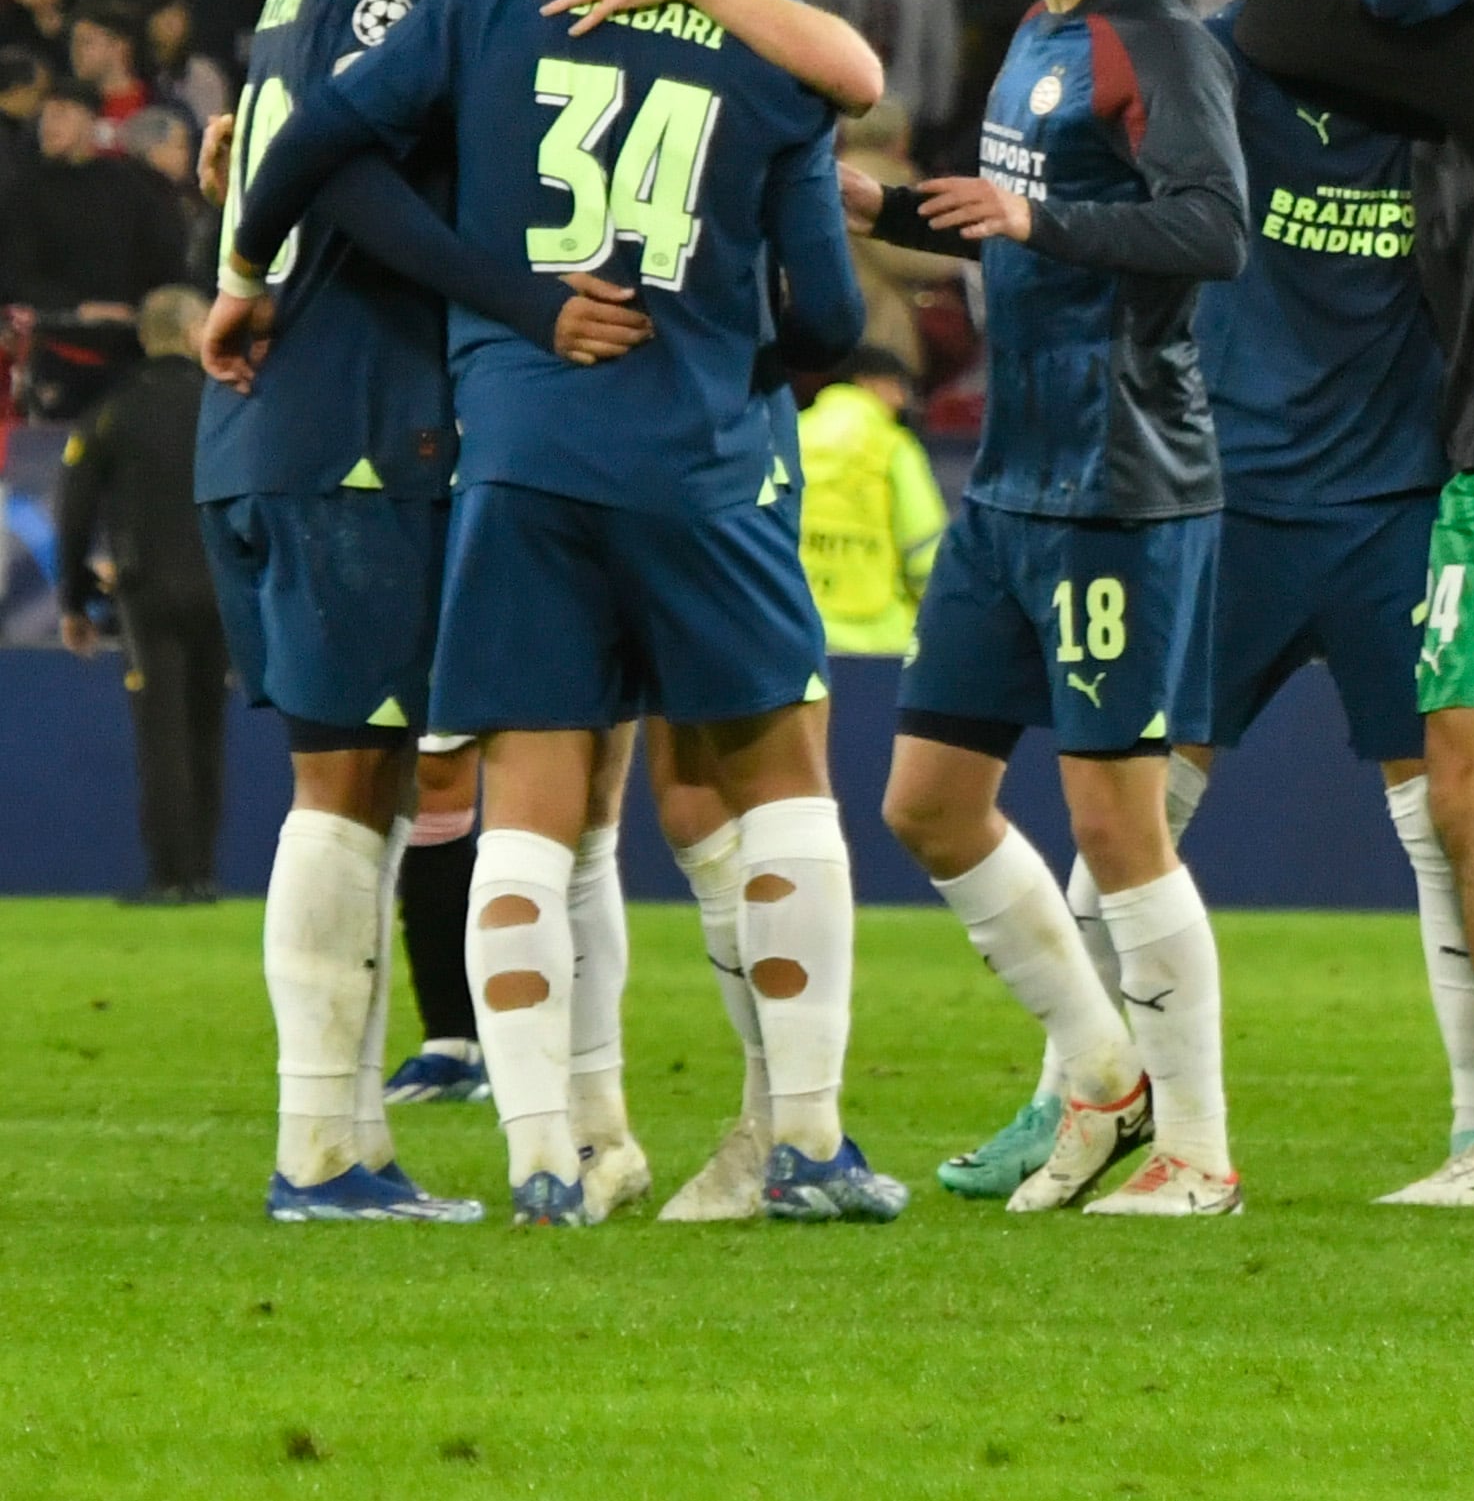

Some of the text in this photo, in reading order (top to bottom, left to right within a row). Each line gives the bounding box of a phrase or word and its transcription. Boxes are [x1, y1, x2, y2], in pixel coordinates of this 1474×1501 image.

[526, 57, 722, 293] 34
[1051, 577, 1126, 663] 18
[1425, 563, 1467, 643] 4
